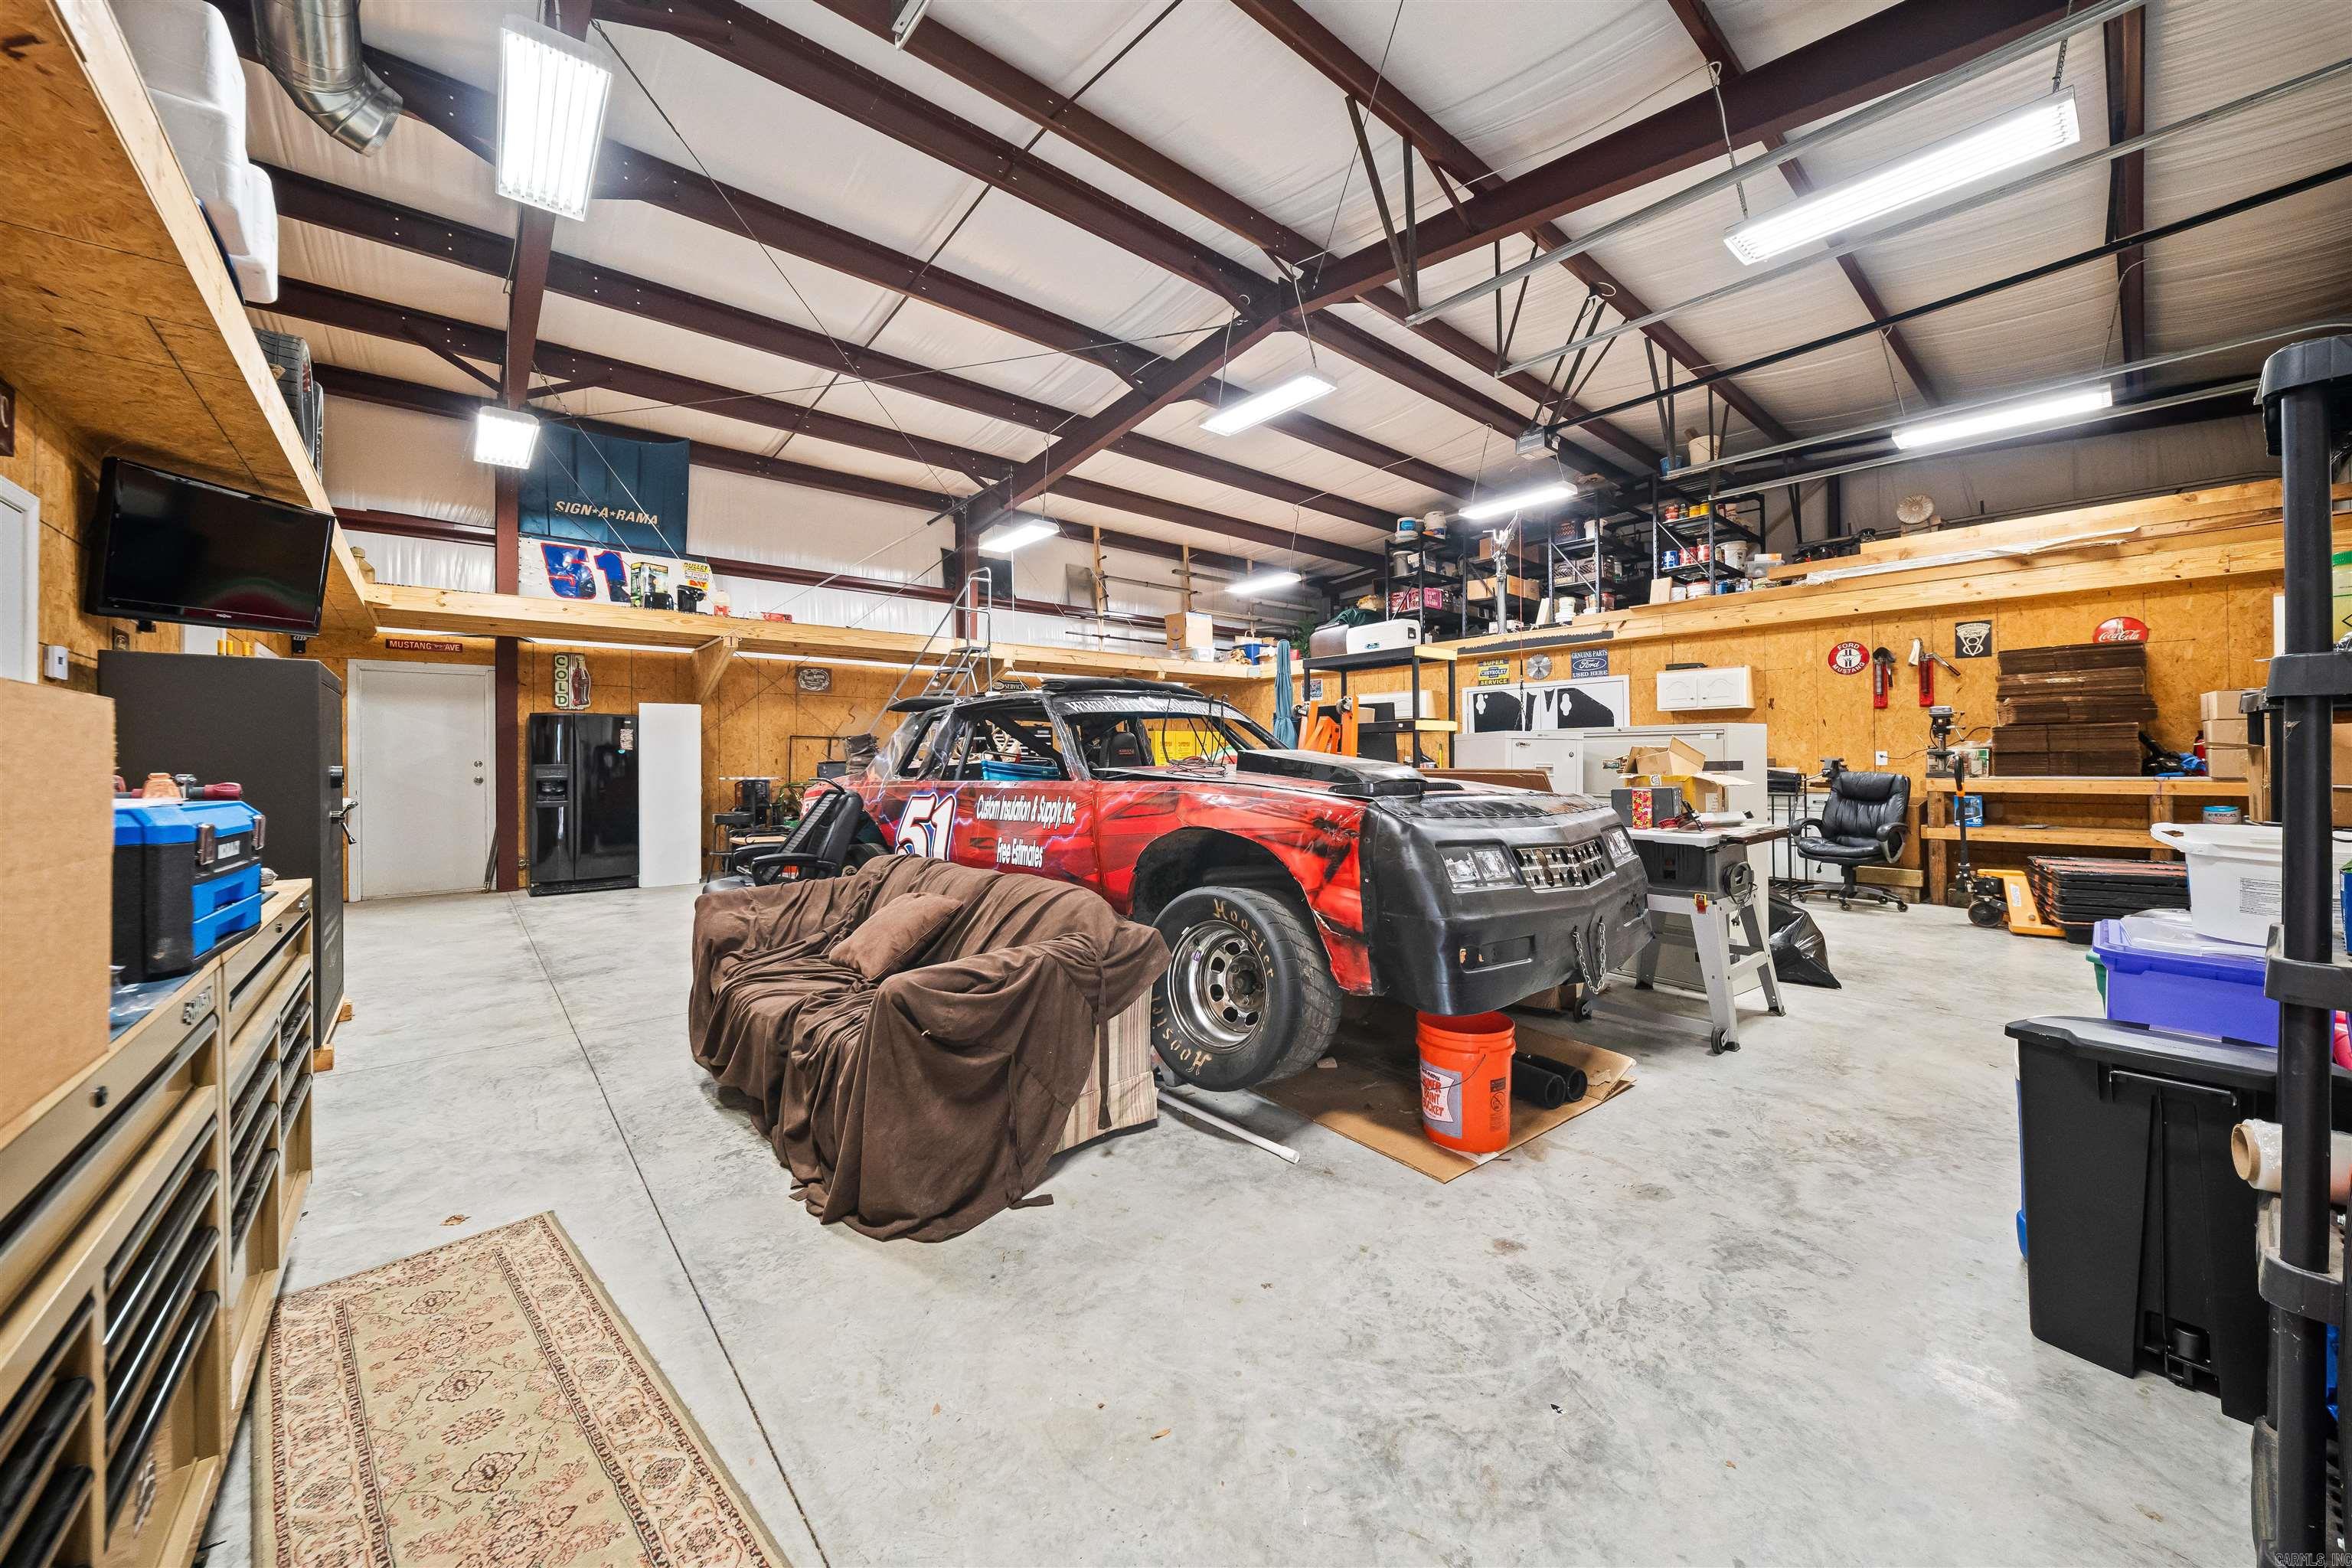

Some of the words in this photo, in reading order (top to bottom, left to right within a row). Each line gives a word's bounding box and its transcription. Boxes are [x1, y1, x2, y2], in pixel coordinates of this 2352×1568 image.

[541, 542, 631, 603] 51
[389, 640, 432, 651] MUSTANG
[444, 643, 460, 652] AVE
[1571, 651, 1592, 659] GENUINE
[1592, 649, 1608, 658] PARTS
[1837, 642, 1860, 651] FORD
[1481, 668, 1508, 676] CHEVROLET
[1579, 658, 1600, 668] Ford
[1831, 662, 1866, 674] MUSTANG
[555, 655, 567, 705] COLD
[976, 795, 999, 820] Custom
[1000, 798, 1031, 822] Insulation
[1031, 795, 1038, 822] &
[1038, 795, 1063, 829] Supply,
[1063, 797, 1076, 825] Inc.
[895, 792, 956, 861] 51
[996, 837, 1011, 864] Free
[1011, 838, 1044, 868] Estimates
[1212, 897, 1275, 978] Hoosier
